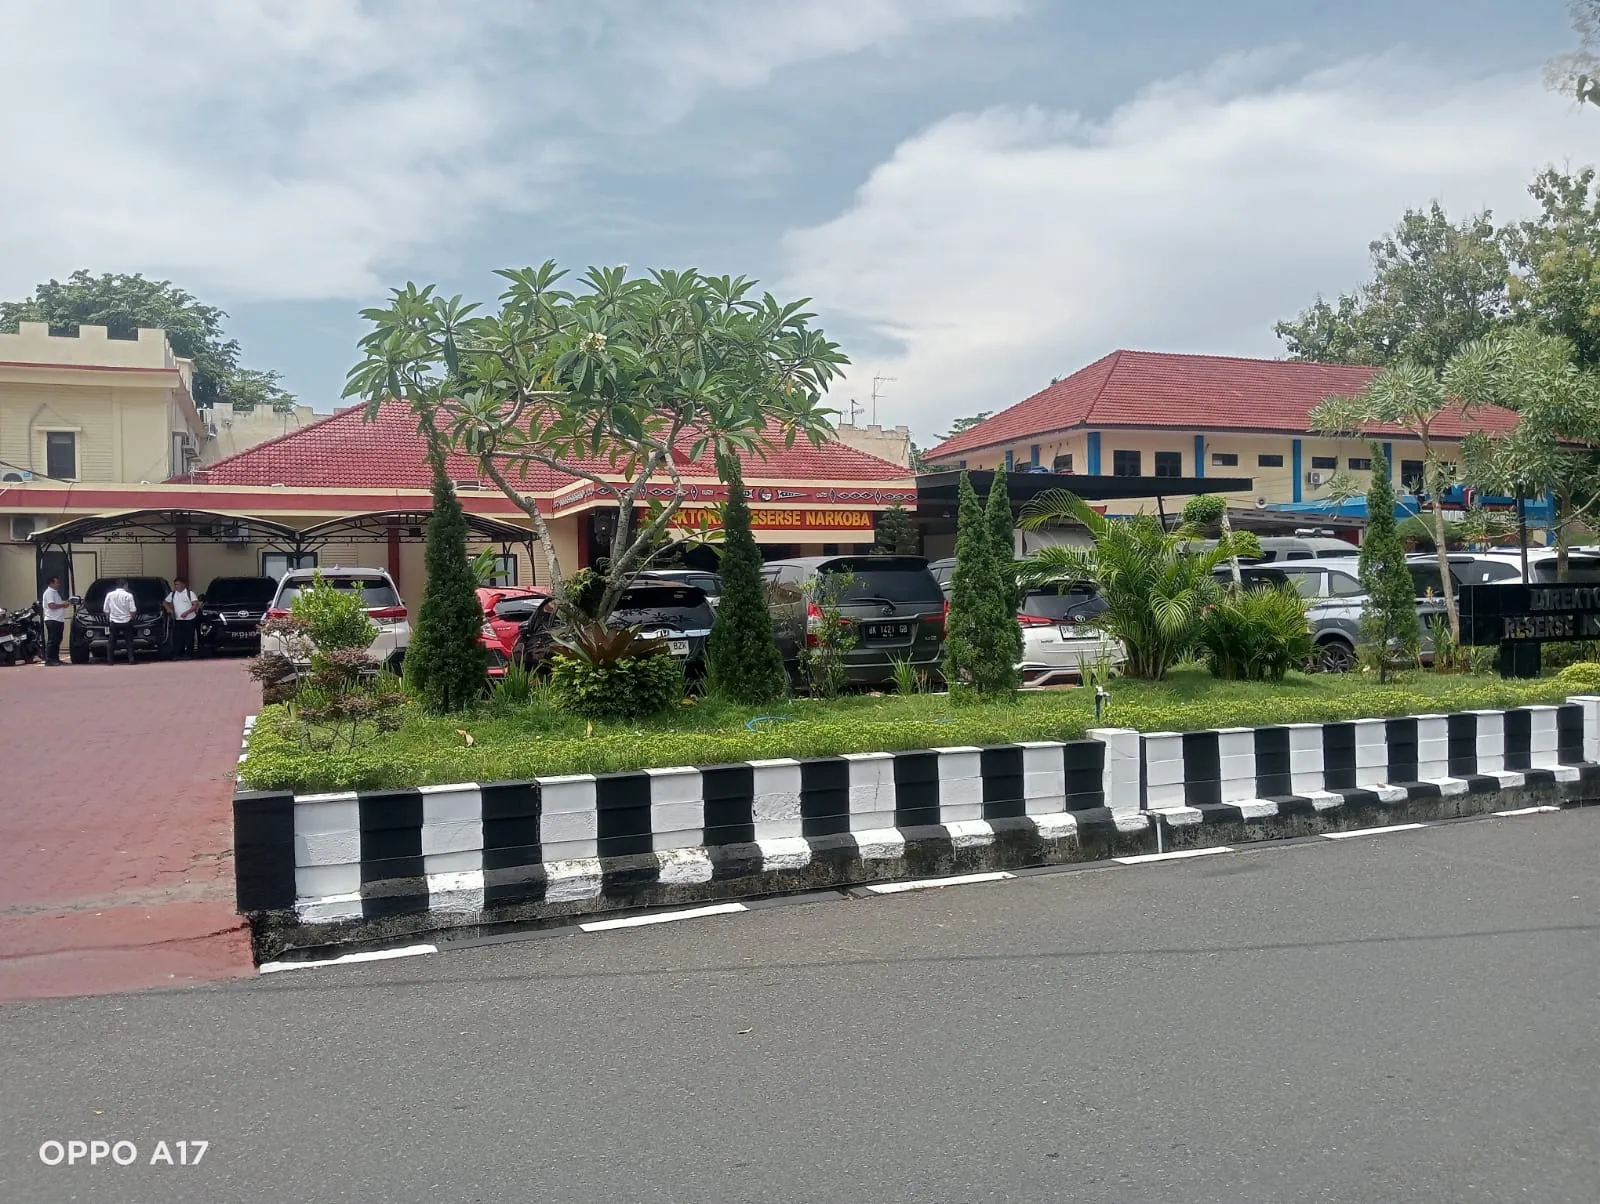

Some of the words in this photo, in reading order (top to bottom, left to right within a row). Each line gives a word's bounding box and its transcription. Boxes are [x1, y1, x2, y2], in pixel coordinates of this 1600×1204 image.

[749, 509, 801, 525] ESERSE
[805, 510, 871, 526] NARKOBA
[1504, 615, 1574, 639] RESERSE
